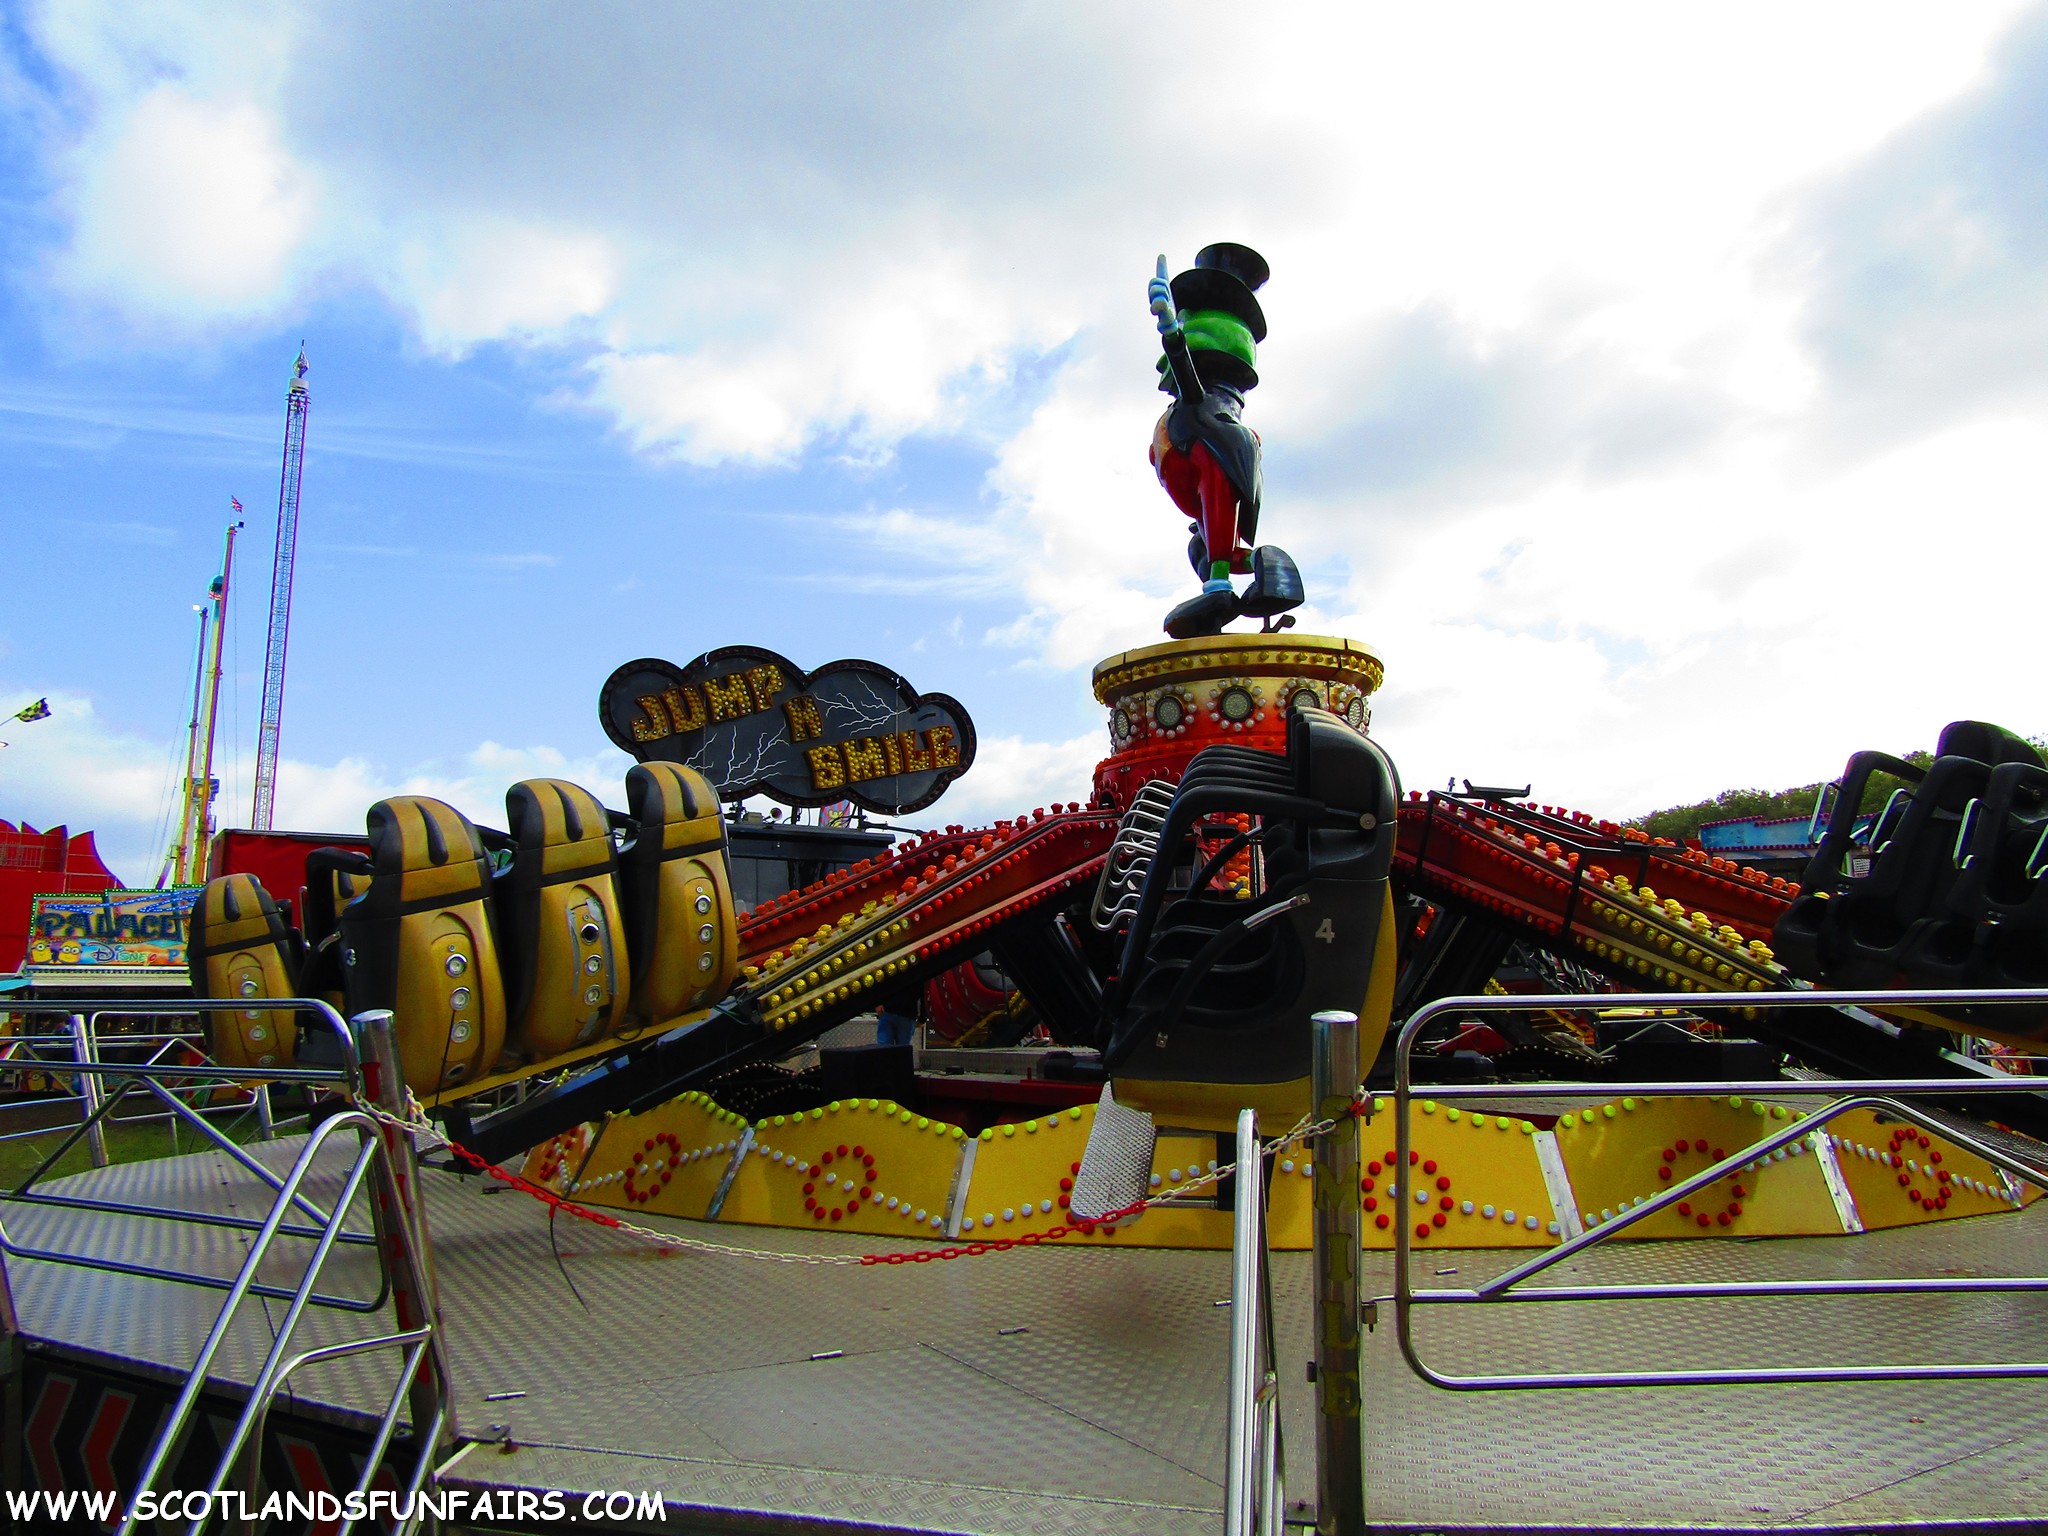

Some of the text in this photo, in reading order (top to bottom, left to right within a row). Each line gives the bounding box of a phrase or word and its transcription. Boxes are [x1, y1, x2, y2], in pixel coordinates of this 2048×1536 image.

[631, 664, 785, 742] JUMP
[784, 695, 823, 742] N
[806, 726, 960, 789] SMILE
[1315, 918, 1335, 943] 4
